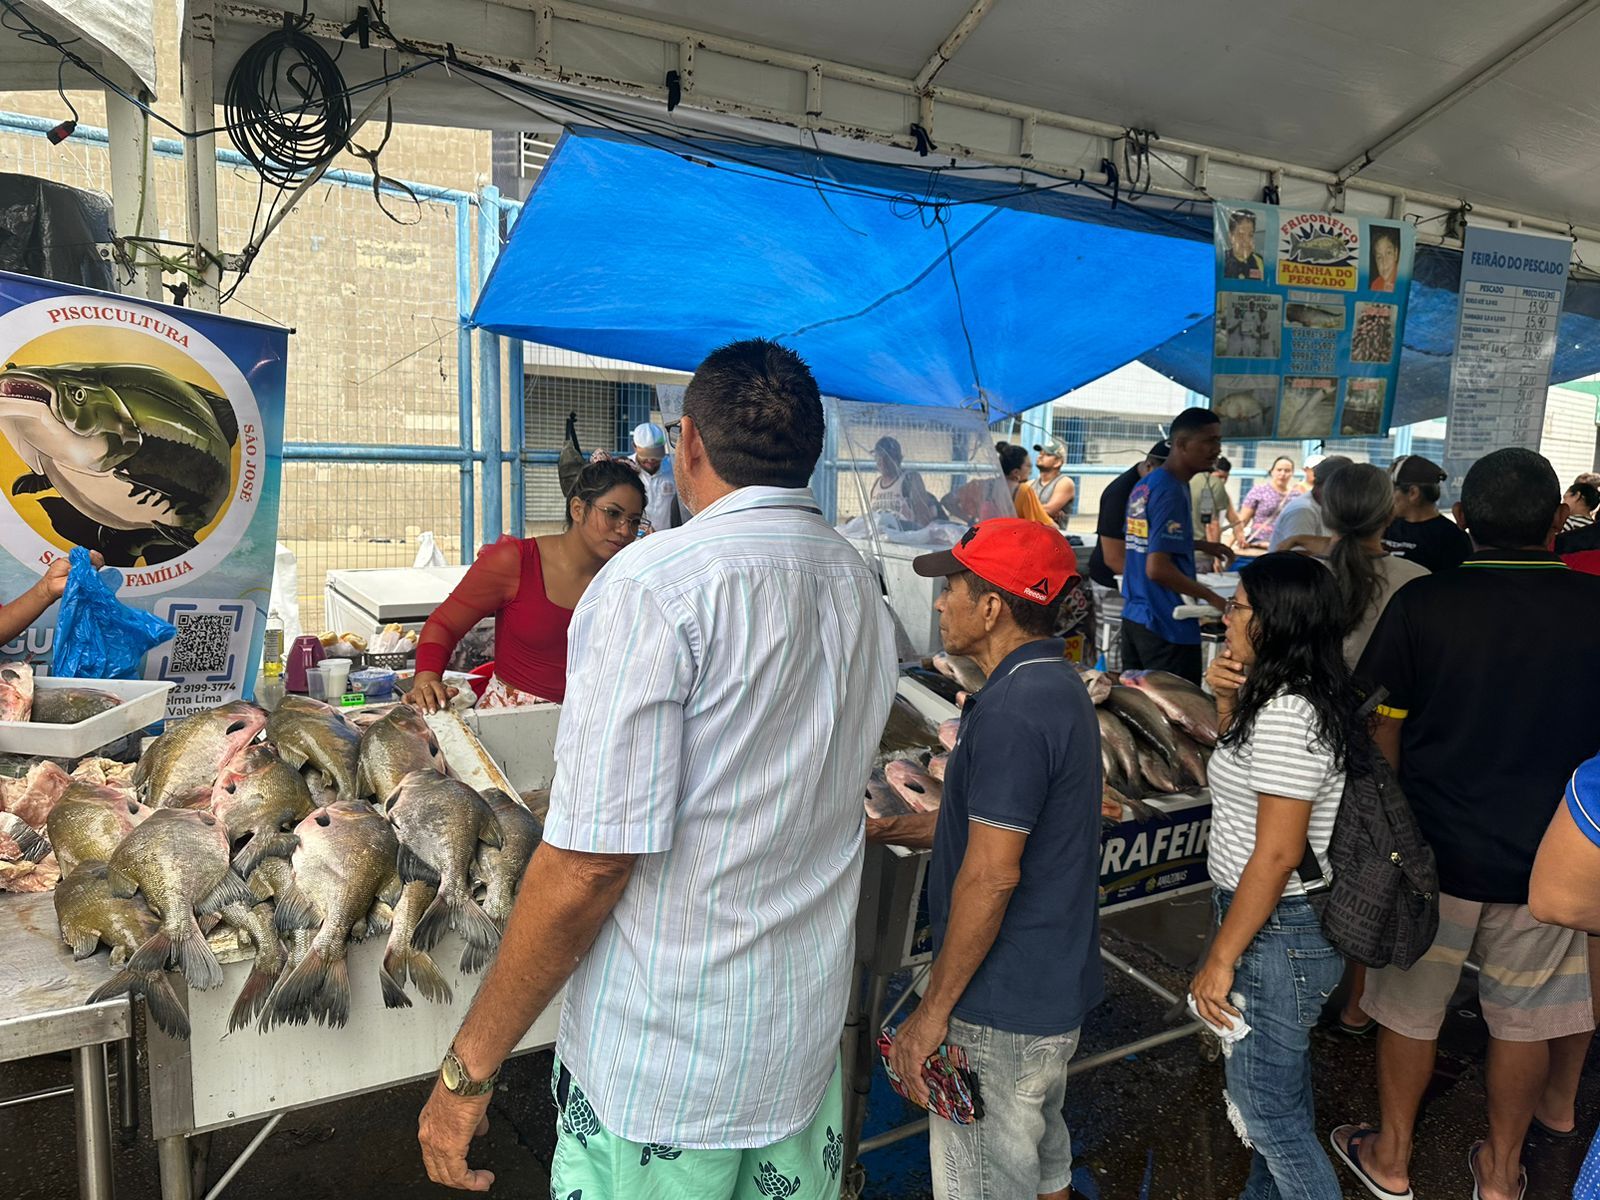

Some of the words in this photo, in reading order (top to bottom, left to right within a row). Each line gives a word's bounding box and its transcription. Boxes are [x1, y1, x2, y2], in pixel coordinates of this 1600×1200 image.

[1282, 264, 1333, 278] RAINHA
[1336, 269, 1353, 279] DO
[1471, 251, 1505, 268] FEIRÃO
[1507, 257, 1521, 269] DO
[1523, 260, 1564, 275] PESCADO
[1288, 274, 1346, 287] PESCADO
[1480, 285, 1504, 293] PESCADO
[47, 305, 190, 349] PISCICULTURA
[243, 424, 258, 456] SÃO
[240, 460, 256, 502] JOSÉ
[125, 560, 194, 587] FAMÍLIA
[1023, 587, 1047, 601] Reebok
[184, 682, 236, 693] 9199-3774
[195, 694, 222, 704] Lima
[1099, 818, 1212, 876] RAFEIR
